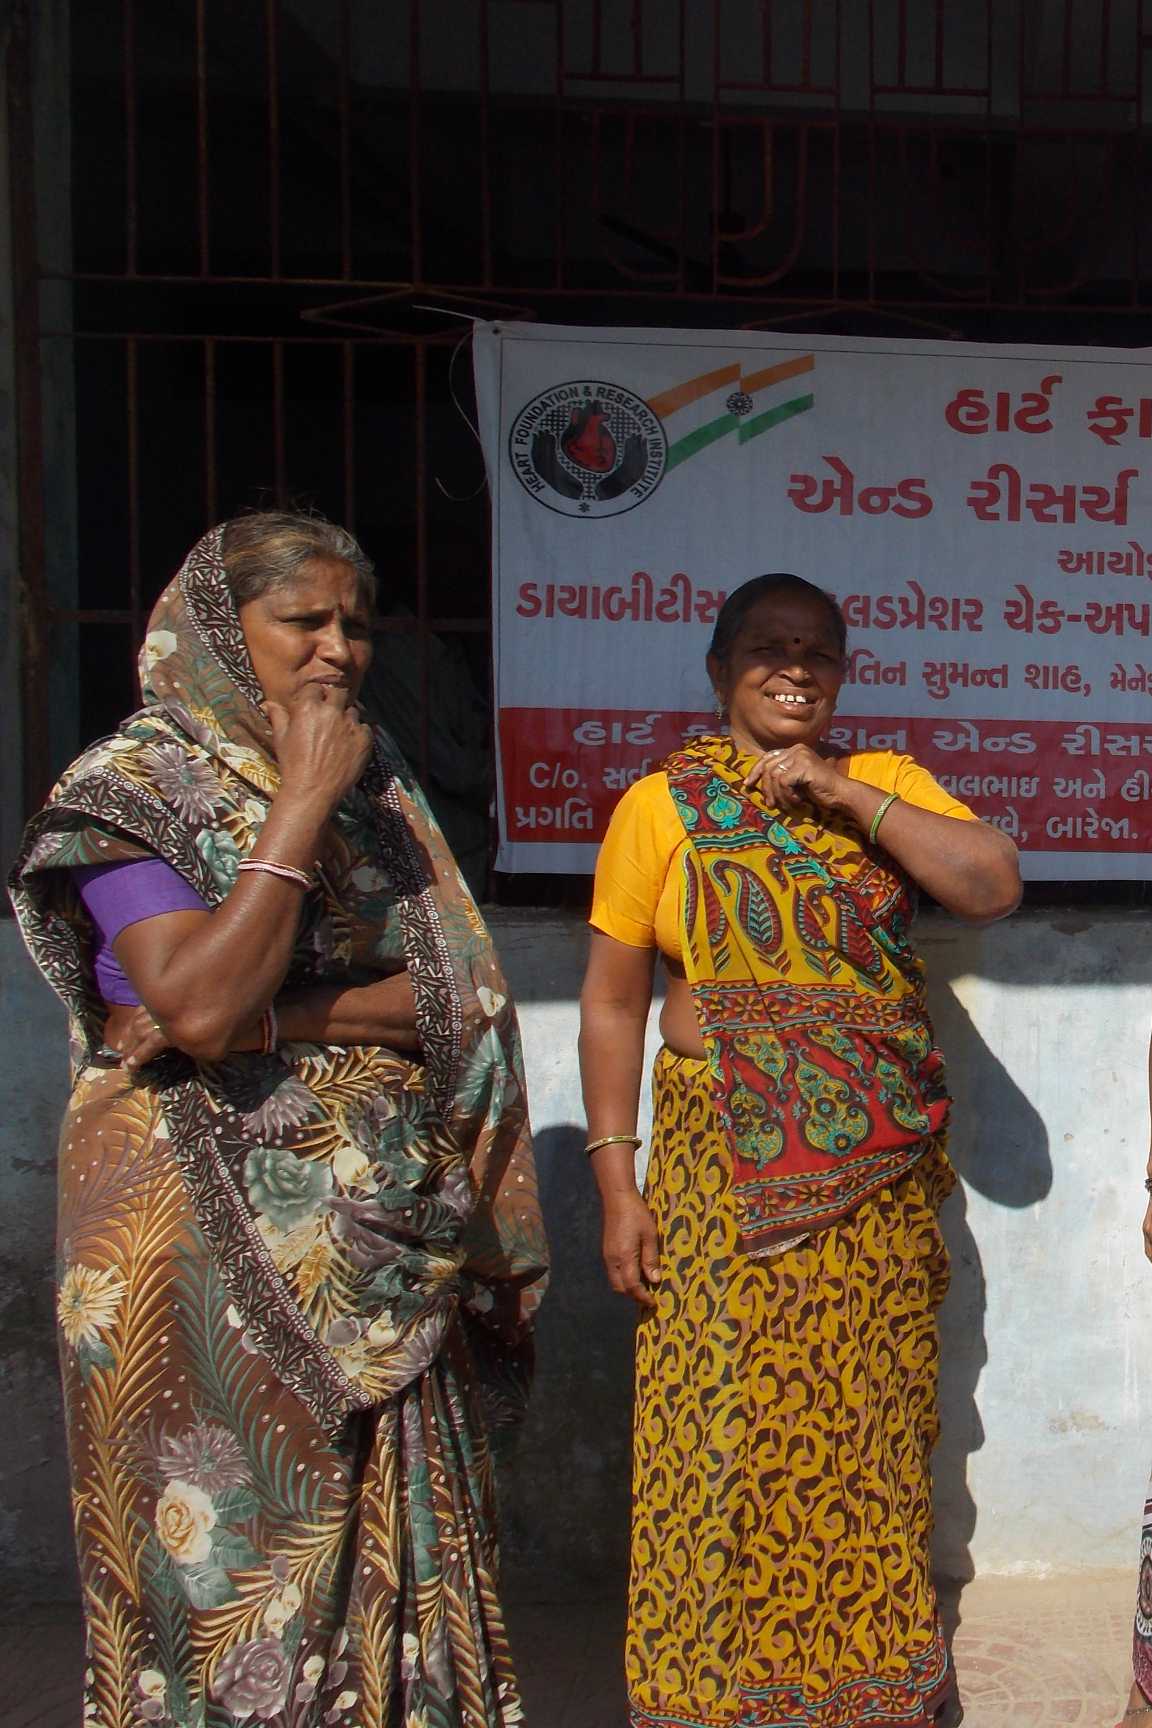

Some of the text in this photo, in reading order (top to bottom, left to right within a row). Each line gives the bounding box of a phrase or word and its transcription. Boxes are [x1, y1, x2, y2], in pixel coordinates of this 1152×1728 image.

[944, 374, 1062, 434] હાર્ટ
[514, 385, 664, 499] HEART FOUNDATION & RESEARCH INSTITUTE
[787, 455, 934, 519] એન્ડ
[967, 463, 1138, 526] રીસર્ચ
[840, 580, 984, 632] લડપ્રેશર
[1003, 585, 1150, 637] ચેક-અપ
[922, 661, 1009, 700] સુમન્ત
[1024, 662, 1092, 696] શાહ,
[573, 715, 662, 746] હાર્ટ
[932, 722, 1037, 754] એન્ડ
[529, 762, 588, 789] C/o.
[1053, 769, 1106, 800] અને
[515, 797, 593, 830] પ્રગતિ
[1046, 806, 1138, 840] બારેજા.
